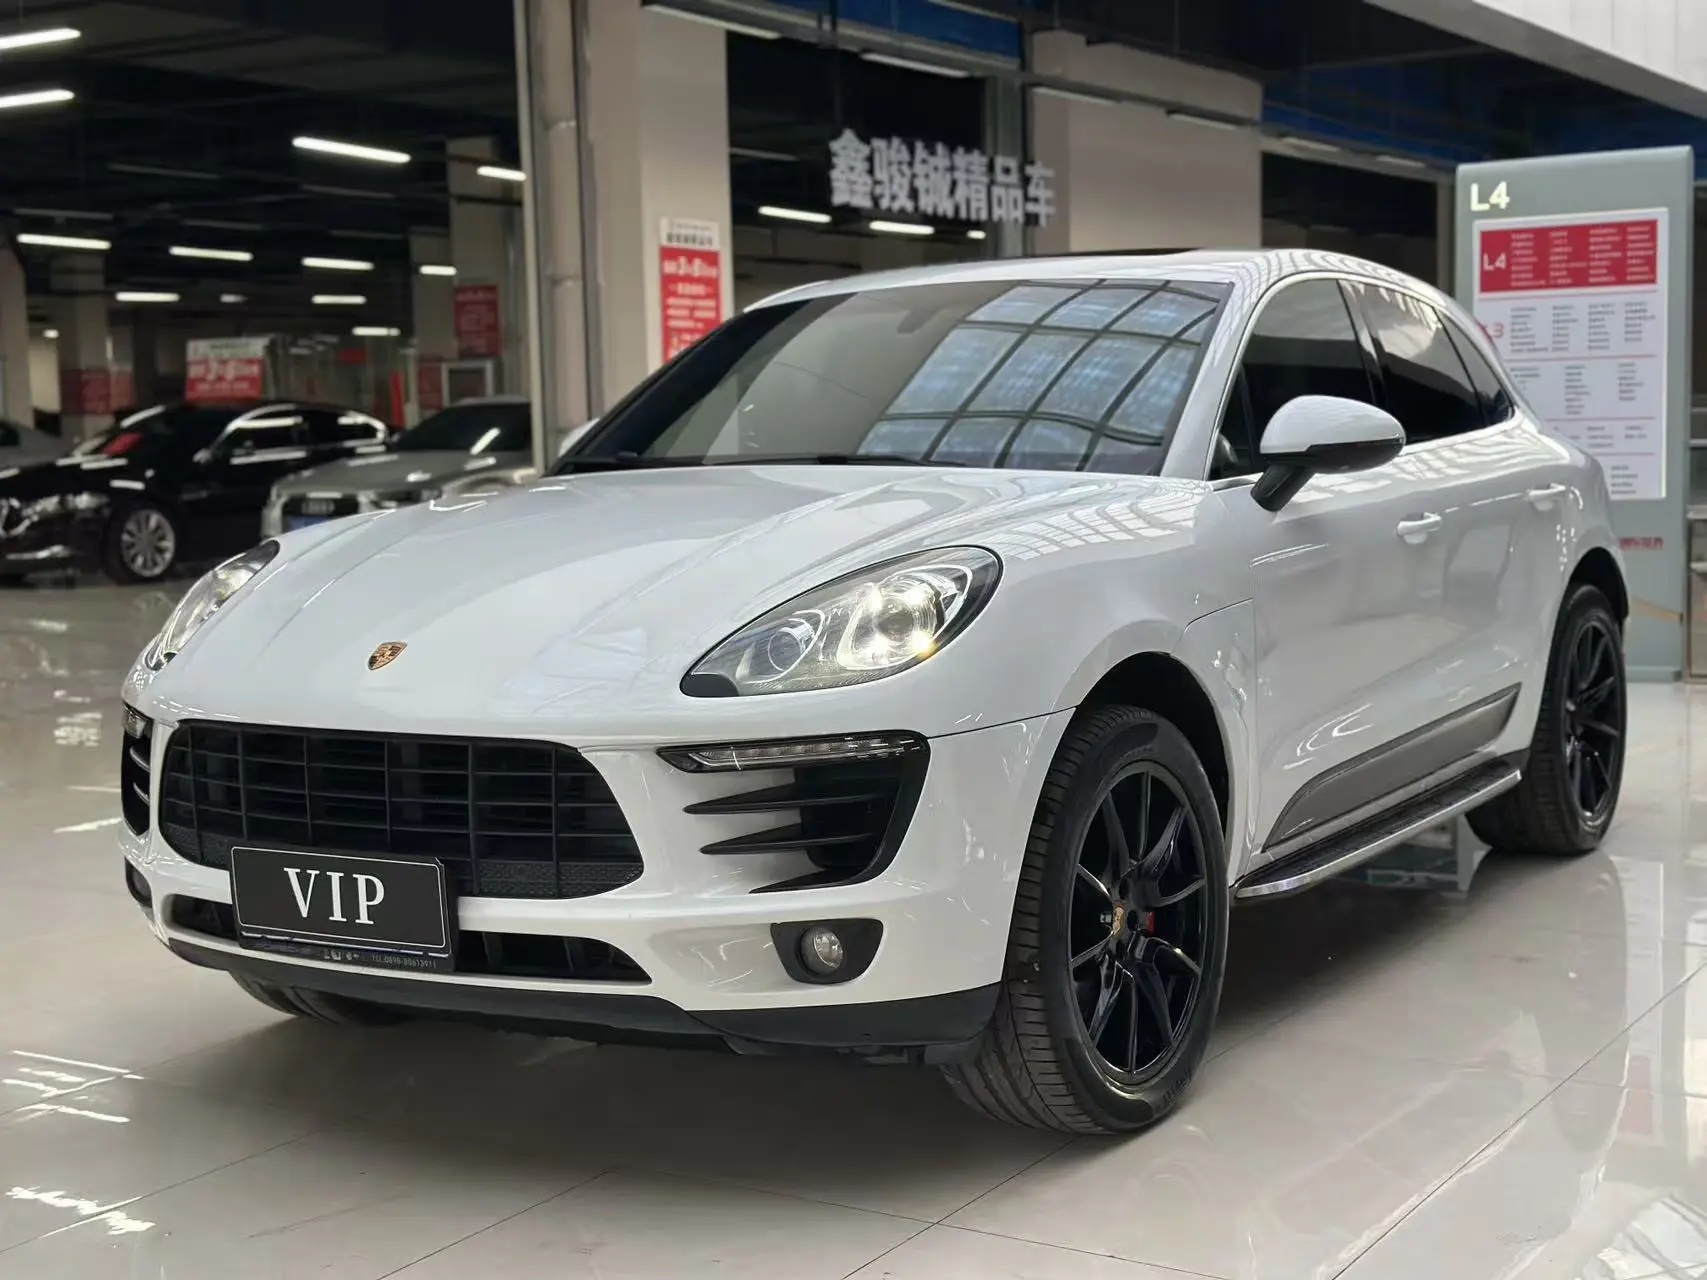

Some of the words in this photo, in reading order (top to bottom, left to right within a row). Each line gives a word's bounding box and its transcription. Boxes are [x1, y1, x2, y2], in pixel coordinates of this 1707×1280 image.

[1470, 181, 1510, 211] L4
[1482, 253, 1507, 271] L4
[283, 867, 385, 925] VIP
